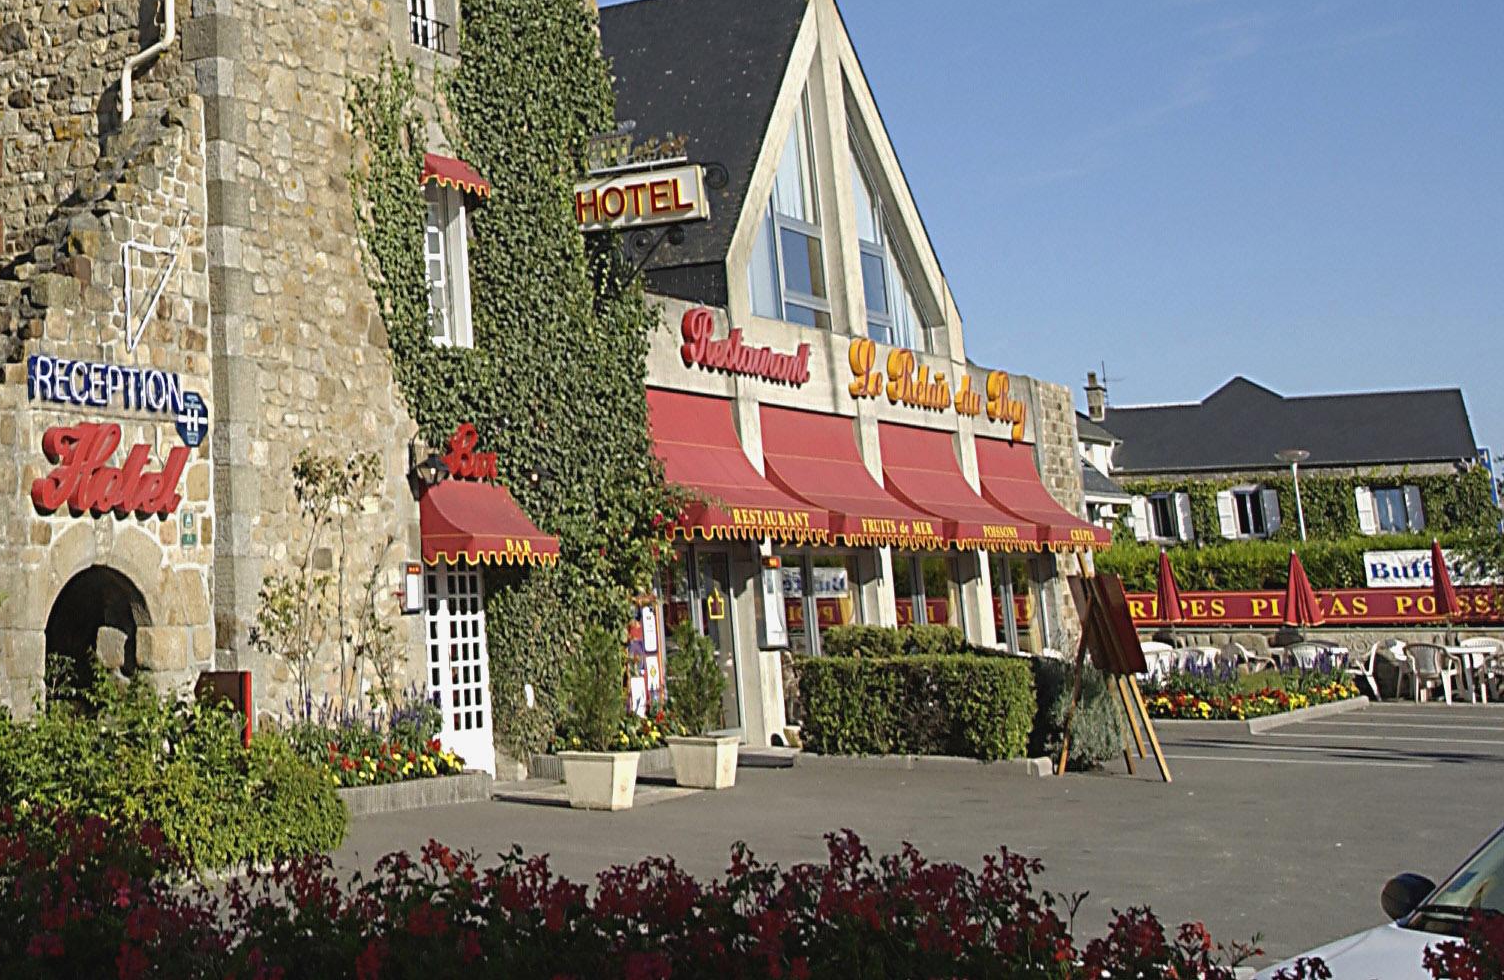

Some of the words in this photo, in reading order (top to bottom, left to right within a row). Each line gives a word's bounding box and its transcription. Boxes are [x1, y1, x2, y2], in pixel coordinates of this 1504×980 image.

[575, 177, 694, 224] HOTEL
[680, 308, 811, 388] Restaurant
[28, 355, 184, 413] RECEPTION
[849, 338, 883, 400] Le
[886, 347, 952, 413] Relais
[954, 374, 981, 416] du
[986, 370, 1027, 445] Roy
[31, 422, 192, 521] Hotel
[441, 422, 498, 480] Bar
[733, 508, 810, 527] RESTAURANT
[861, 518, 896, 533] FRUITS
[912, 521, 934, 534] MER
[506, 538, 532, 552] BAR
[1251, 596, 1369, 617] PIAS
